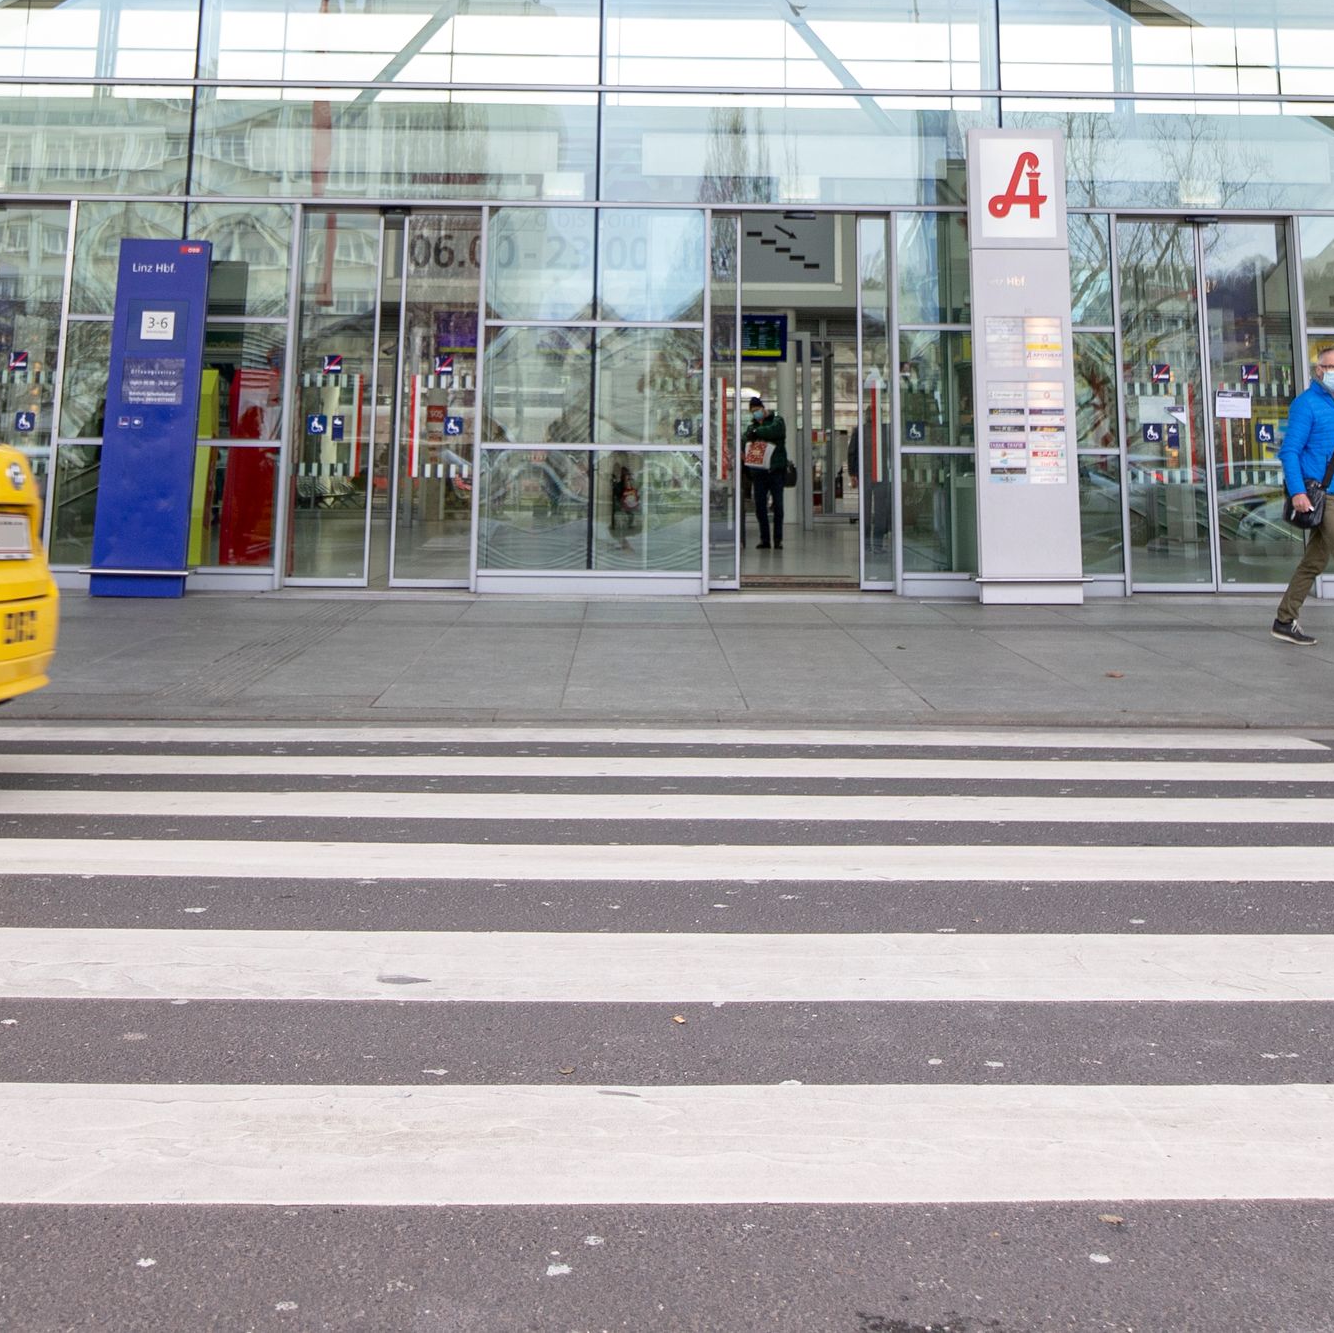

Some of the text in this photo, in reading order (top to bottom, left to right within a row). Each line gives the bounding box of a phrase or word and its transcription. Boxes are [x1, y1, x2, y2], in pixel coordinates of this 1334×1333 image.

[547, 235, 648, 270] 2300
[132, 263, 177, 274] Linz Hbf.
[1006, 276, 1027, 287] Hbf
[147, 316, 169, 330] 3-6
